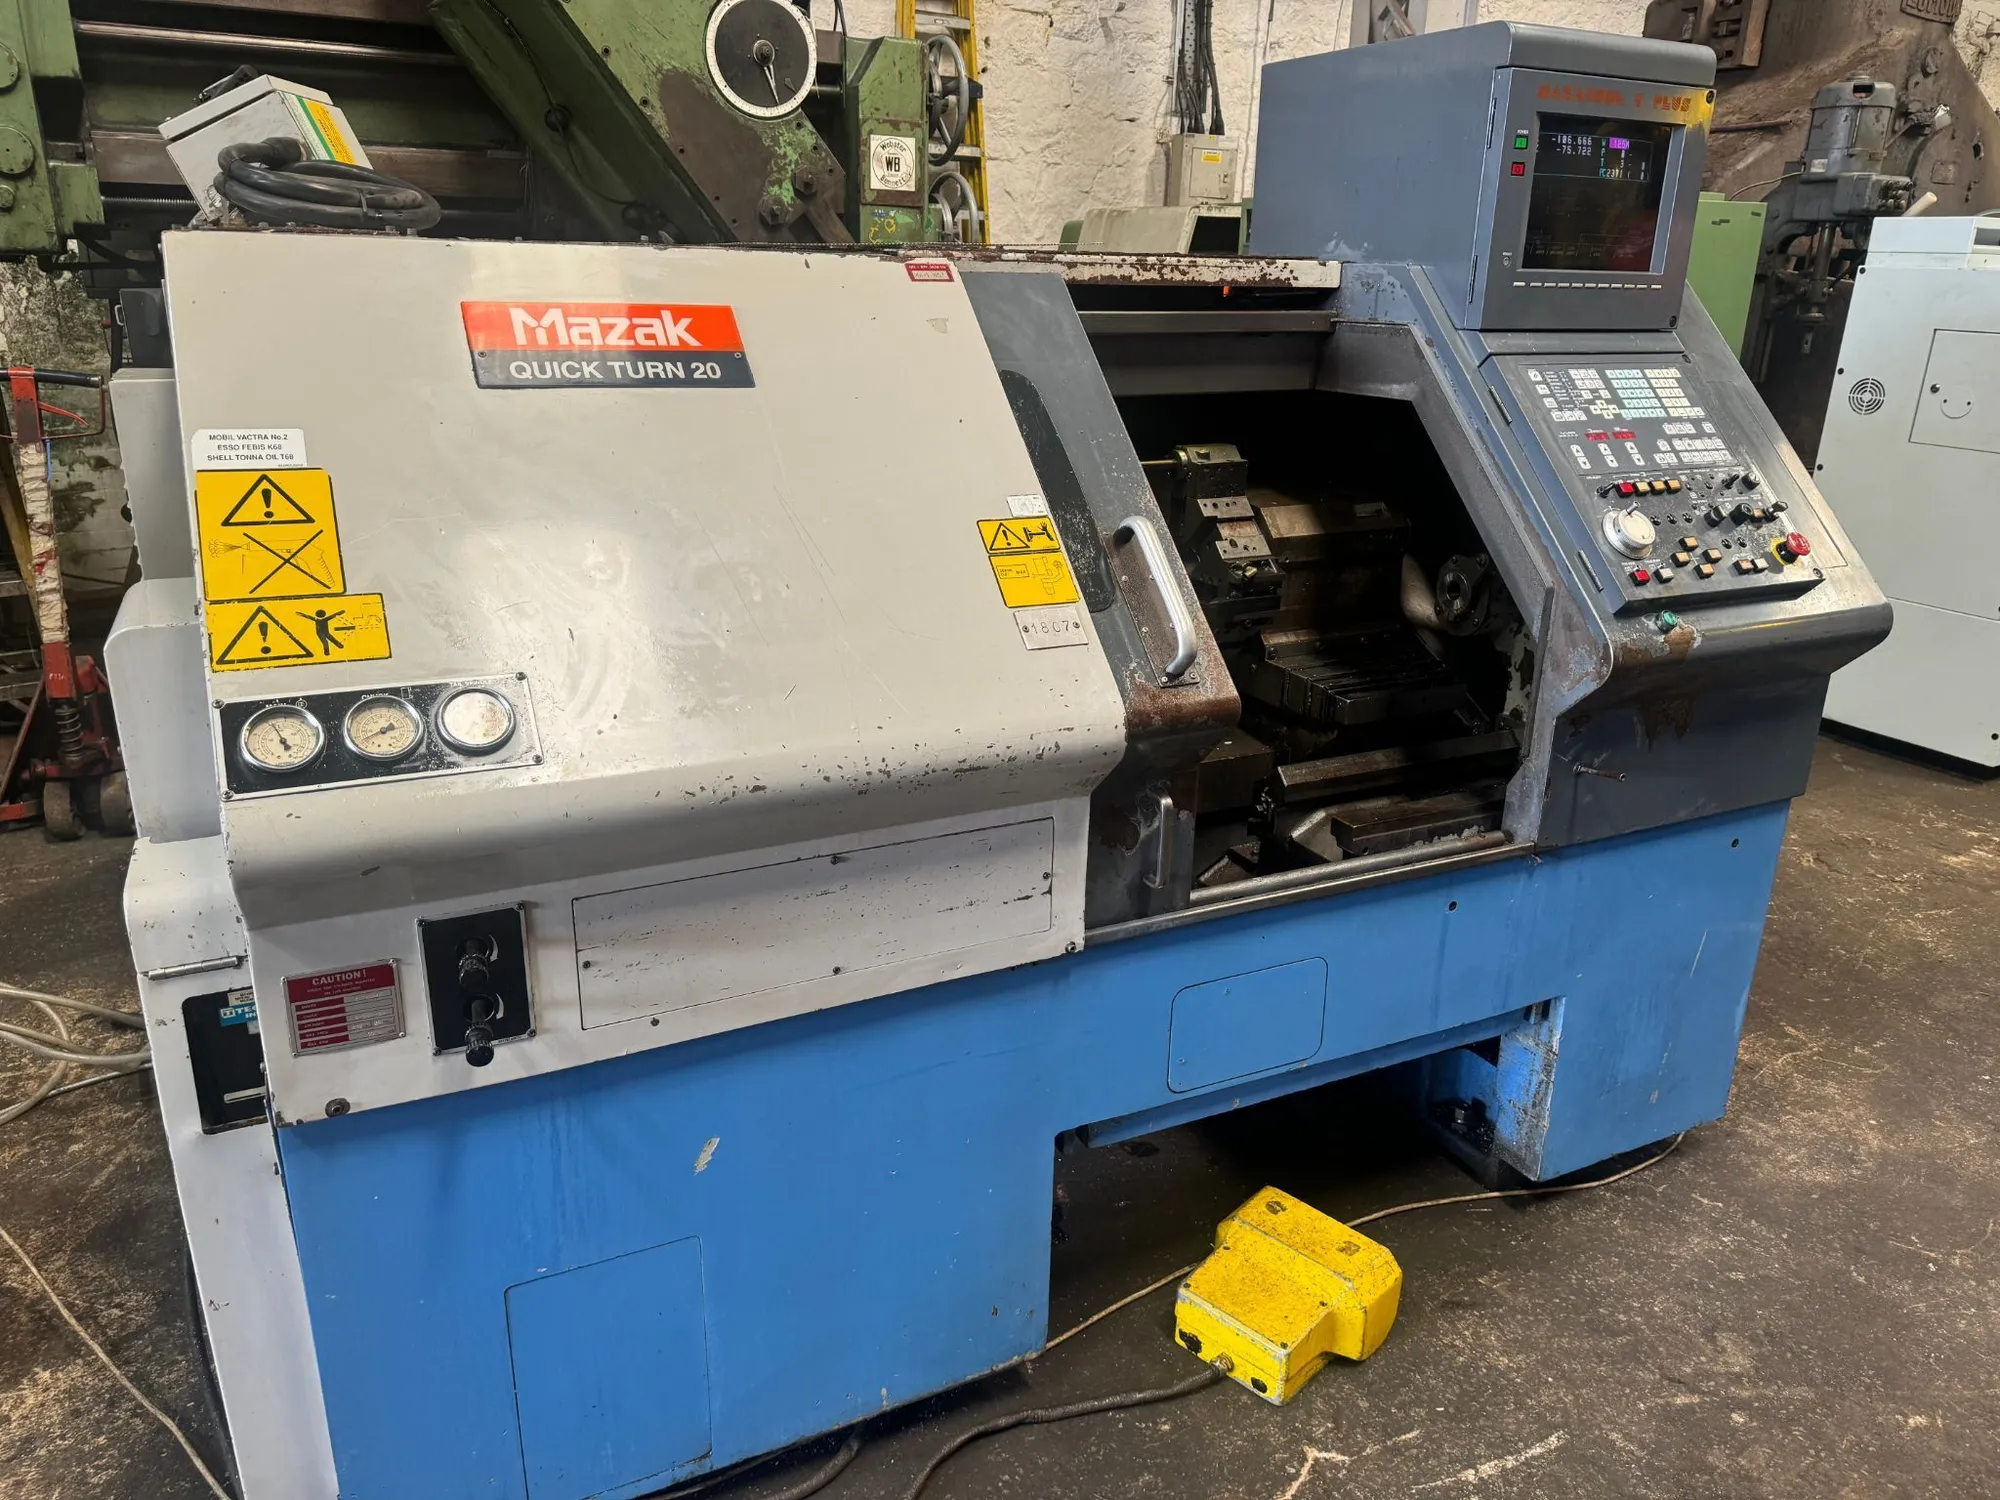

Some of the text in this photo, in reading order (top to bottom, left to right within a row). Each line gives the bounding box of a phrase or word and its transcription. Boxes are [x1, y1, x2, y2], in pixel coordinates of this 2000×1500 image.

[885, 156, 900, 172] WB
[508, 307, 703, 346] Mazak
[509, 361, 721, 380] QUICK TURN 20
[312, 969, 367, 985] CAUTION!
